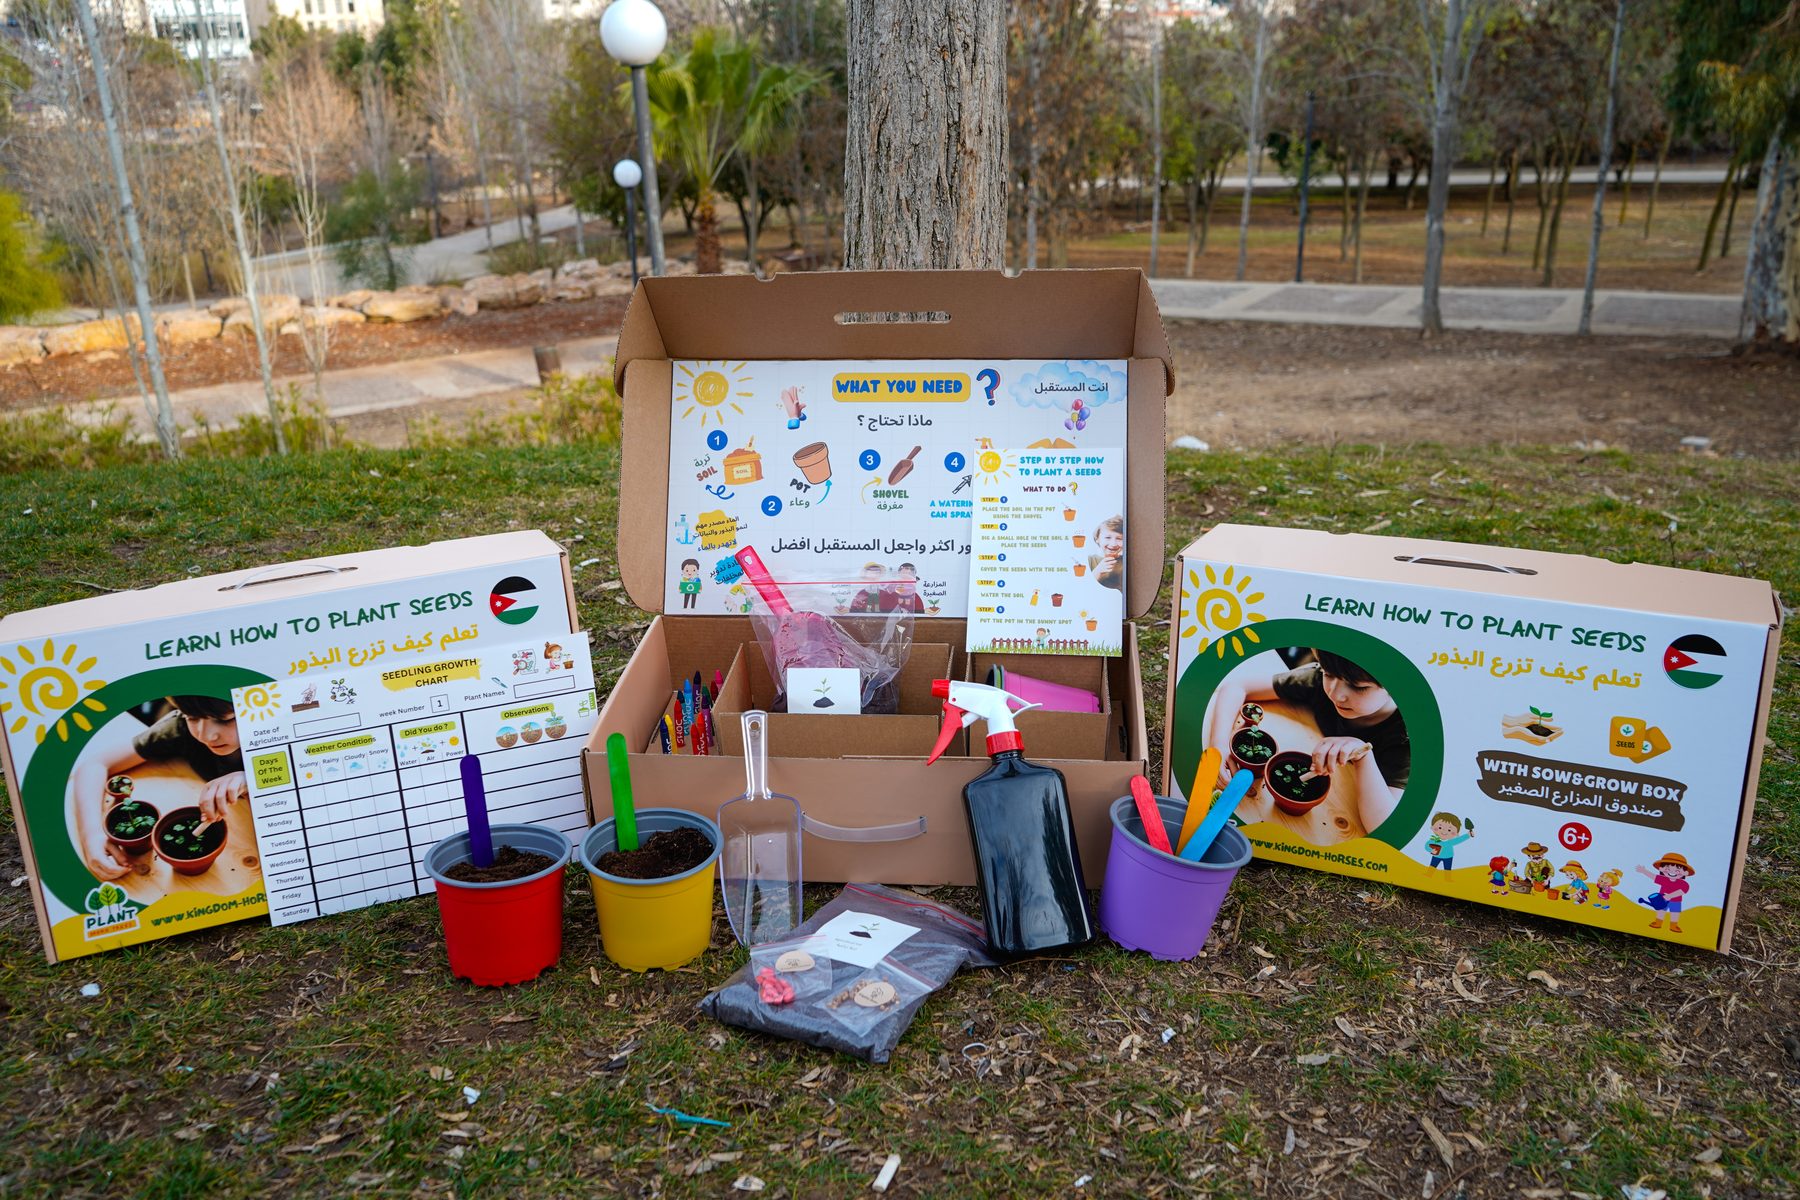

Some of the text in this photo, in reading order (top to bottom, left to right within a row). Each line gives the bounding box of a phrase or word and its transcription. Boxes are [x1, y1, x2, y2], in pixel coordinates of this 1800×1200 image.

[836, 380, 881, 393] WHAT
[886, 380, 917, 393] YOU
[923, 380, 963, 393] NEED
[1034, 381, 1109, 395] انت المستقبل
[867, 415, 904, 431] تحتاج
[908, 415, 933, 427] ماذا
[694, 454, 711, 468] تربة
[696, 466, 718, 482] SOIL
[790, 478, 811, 494] POT
[873, 489, 909, 499] SHOVEL
[790, 497, 810, 508] وعاء
[877, 501, 904, 512] مغرفة
[695, 516, 739, 531] الماء مصدر مهم
[736, 524, 748, 532] لنمو
[719, 527, 735, 535] البذور
[698, 544, 716, 552] بالماء
[771, 537, 810, 554] افضل
[814, 538, 880, 555] المستقبل
[884, 538, 926, 555] واجعل
[929, 538, 955, 555] اكثر
[709, 565, 728, 578] تدوير
[715, 570, 745, 585] لمخلفات
[923, 581, 947, 589] المزارعة
[923, 590, 947, 598] الصغيرة
[145, 590, 473, 661] LEARN HOW TO PLANT SEEDS
[1304, 593, 1646, 652] LEARN HOW TO PLANT SEEDS
[287, 624, 479, 676] تعلم كيف تزرع البذور
[382, 658, 478, 681] SEEDLING GROWTH
[1427, 648, 1642, 691] تعلم كيف تزرع البذور
[415, 675, 449, 688] CHART
[464, 689, 505, 702] Plant Names
[379, 704, 425, 718] week Number
[504, 705, 550, 719] Observations
[253, 726, 280, 737] Date of
[404, 724, 443, 737] Did You do
[249, 734, 289, 747] Agriculture
[304, 736, 376, 755] Weather Conditions
[1616, 740, 1635, 749] SEEDS
[344, 752, 366, 762] Cloudy
[368, 747, 389, 758] Snowy
[445, 749, 464, 758] Power
[259, 757, 278, 767] Days
[299, 760, 319, 770] Sunny
[322, 756, 339, 765] Rainy
[400, 758, 417, 767] Water
[258, 765, 283, 776] Of The
[261, 775, 283, 785] Week
[1483, 757, 1680, 802] WITH SOW&GROW BOX
[264, 799, 288, 809] Sunday
[1498, 782, 1663, 818] صندوق المزارع الصغير
[267, 818, 293, 829] Monday
[1563, 827, 1590, 845] 6+
[271, 838, 297, 848] Tuesday
[269, 857, 305, 869] Wednesday
[276, 874, 305, 885] Thursday
[282, 892, 302, 900] Friday
[87, 909, 136, 929] PLANT
[282, 907, 310, 918] Saturday
